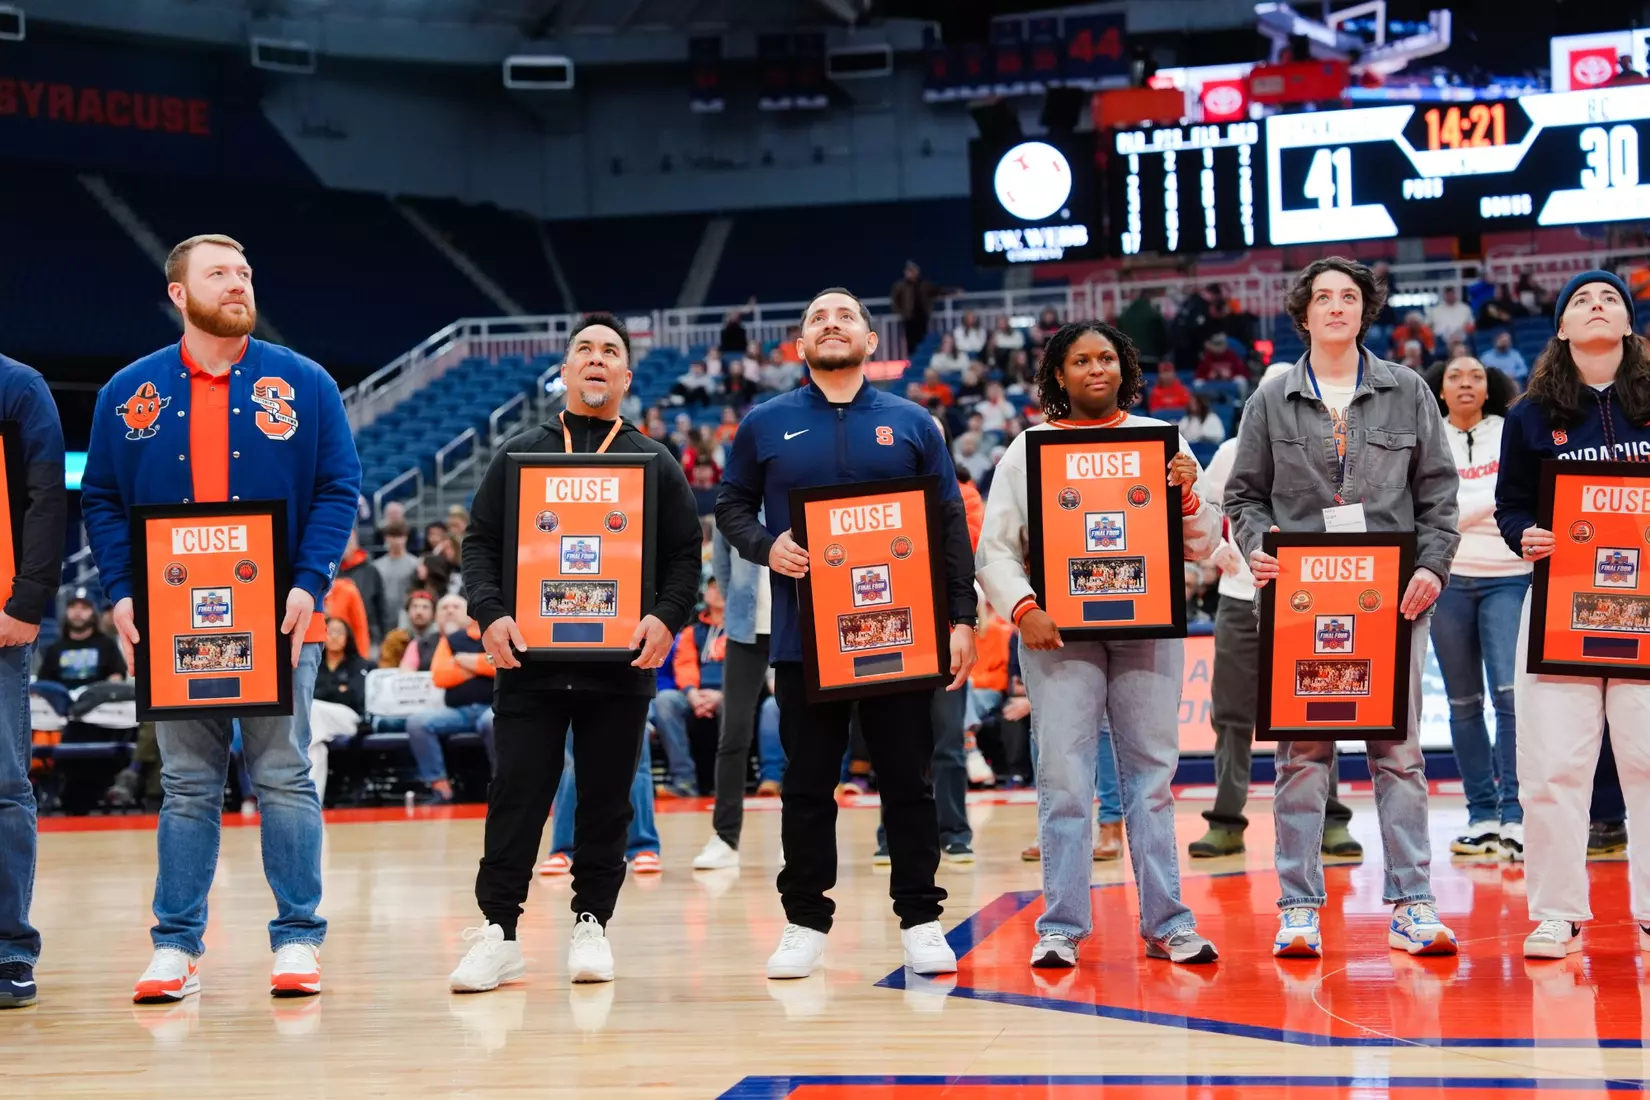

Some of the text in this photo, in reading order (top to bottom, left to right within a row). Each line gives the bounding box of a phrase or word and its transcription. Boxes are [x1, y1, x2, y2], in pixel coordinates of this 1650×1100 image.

[1069, 27, 1124, 62] 44
[0, 78, 211, 135] SYRACUSE
[1424, 103, 1507, 151] 14:21
[1579, 124, 1640, 191] 30
[1304, 146, 1353, 209] 41
[875, 426, 894, 446] S
[1552, 428, 1568, 446] S
[1069, 452, 1134, 478] 'CUSE
[550, 478, 612, 502] 'CUSE
[1586, 487, 1650, 513] 'CUSE
[832, 504, 895, 533] 'CUSE
[175, 526, 240, 553] 'CUSE
[1304, 557, 1368, 581] 'CUSE
[1601, 564, 1632, 573] FINAL FOUR
